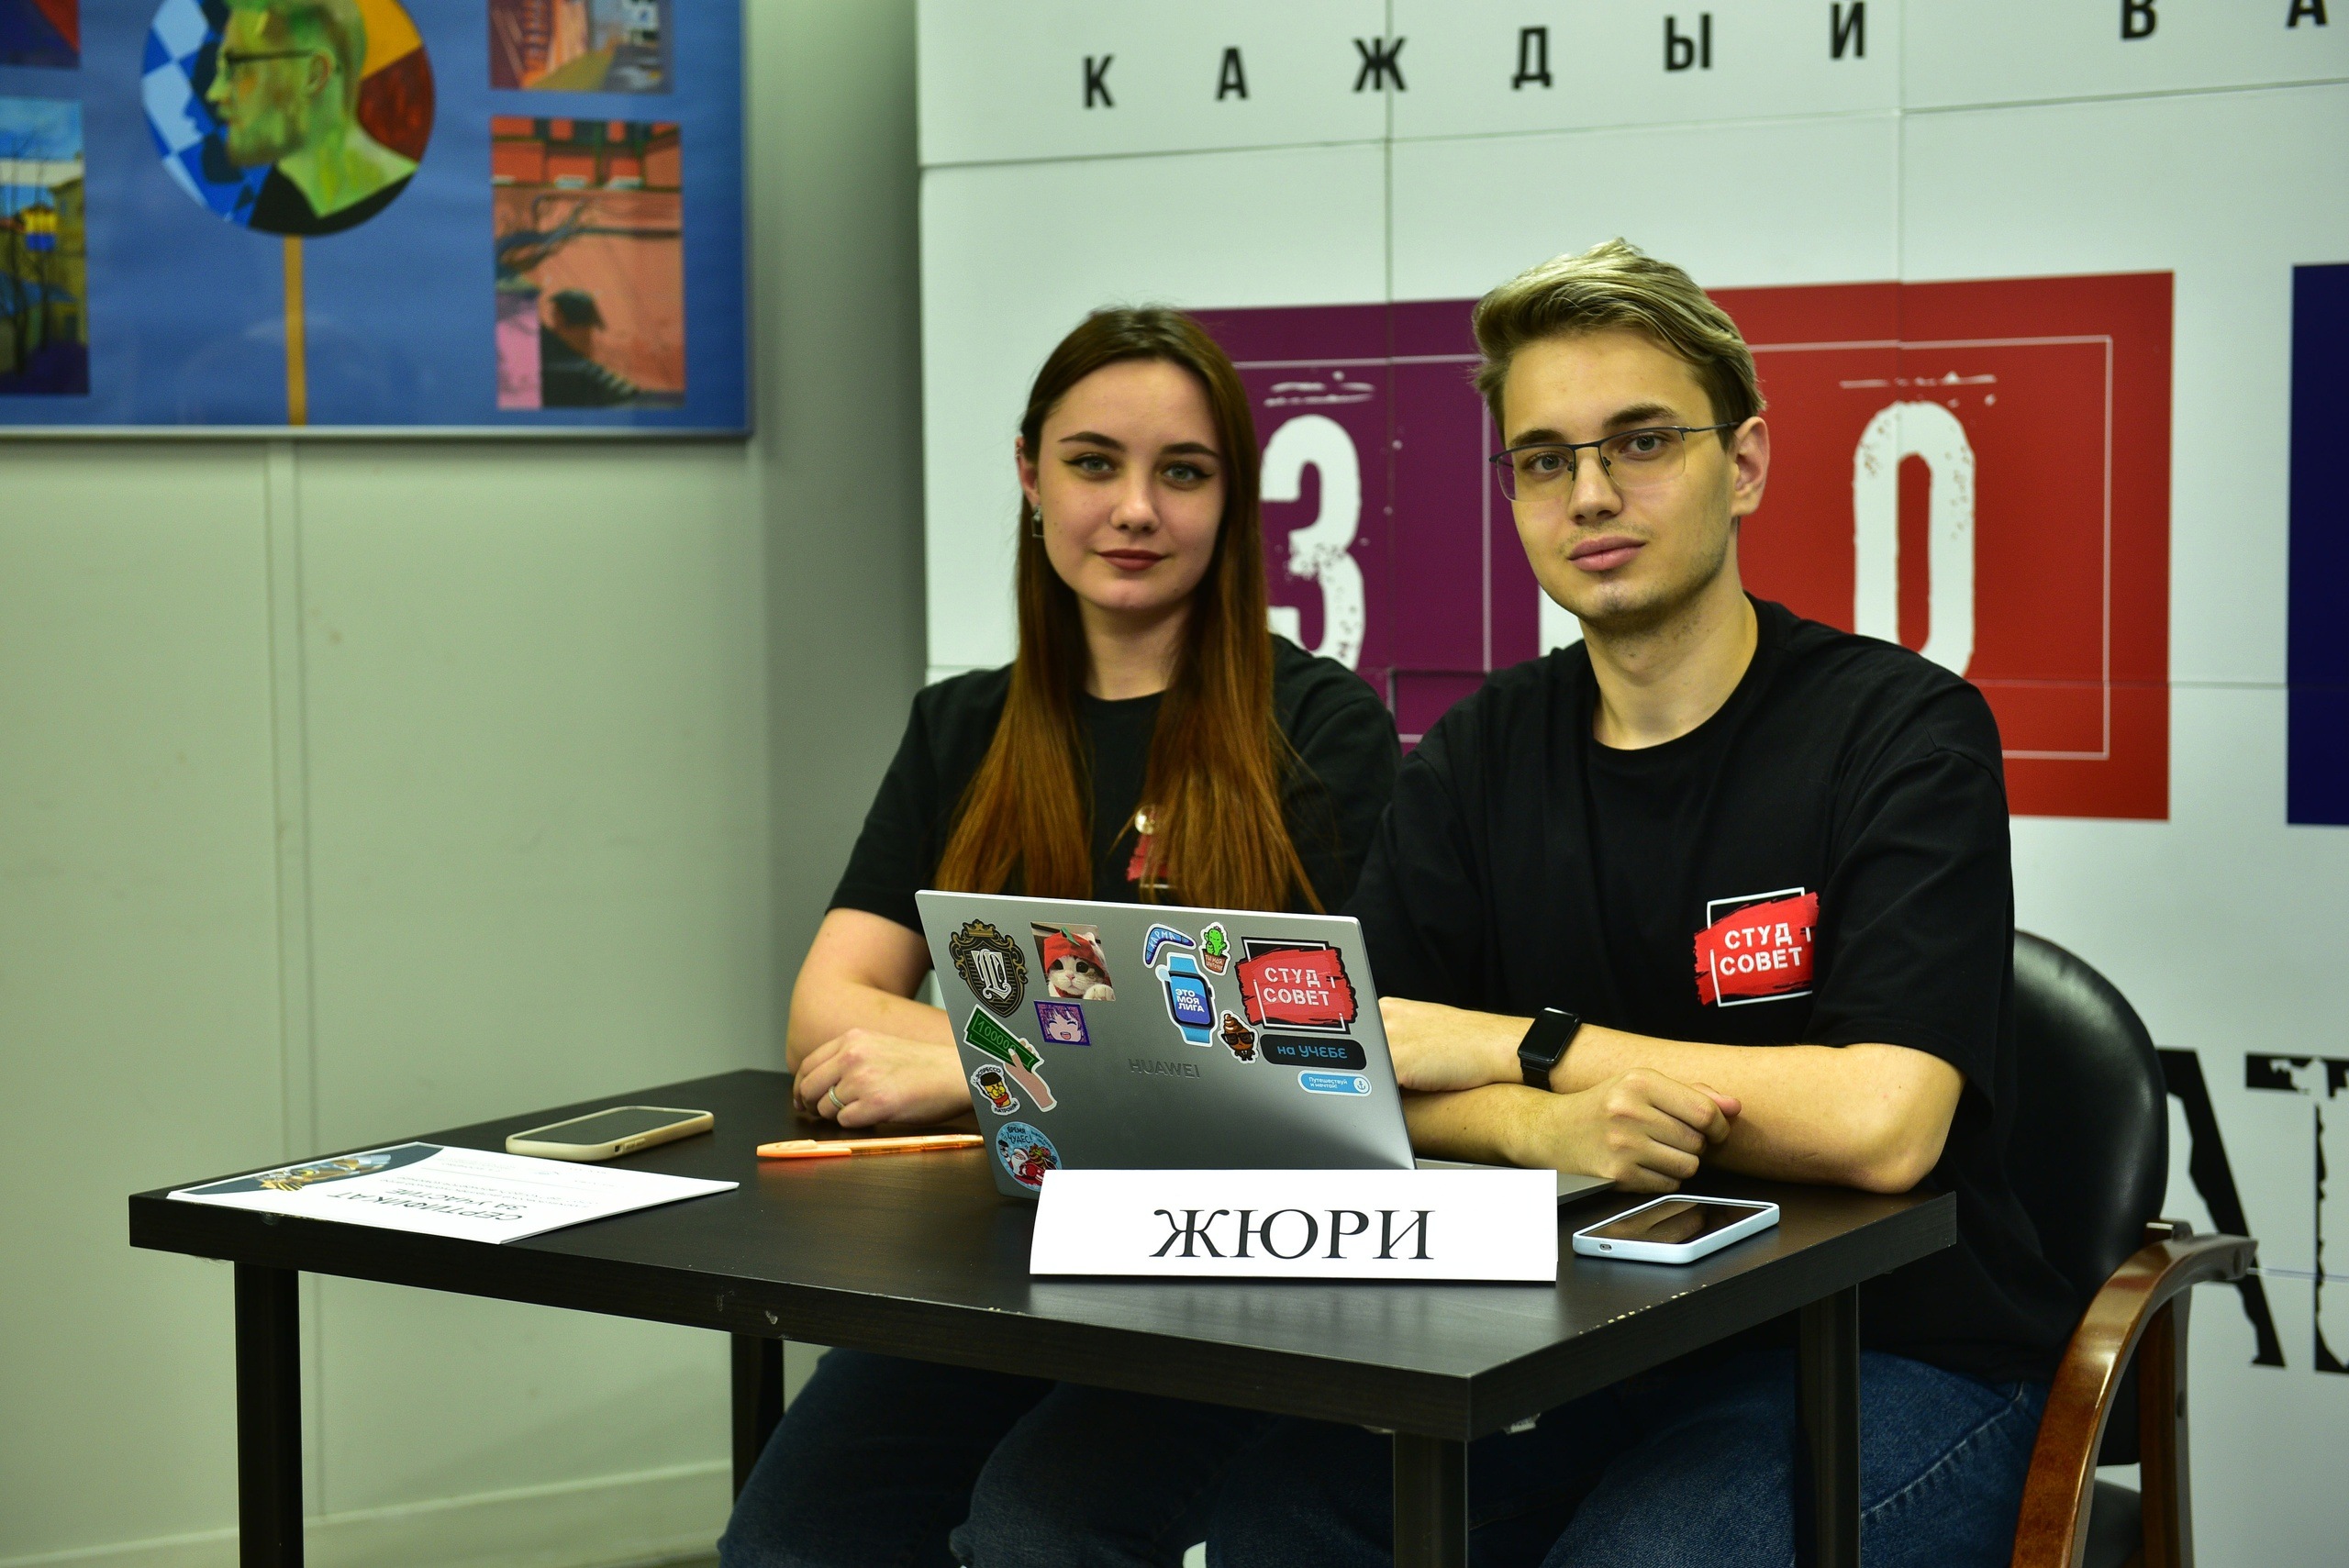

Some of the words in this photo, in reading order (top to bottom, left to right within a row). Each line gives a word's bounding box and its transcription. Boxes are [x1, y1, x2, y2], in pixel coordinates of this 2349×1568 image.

[1149, 930, 1175, 949] КАРМА
[1724, 922, 1793, 950] СТУД
[1719, 946, 1803, 976] СОВЕТ
[1264, 967, 1321, 988] СТУД
[1174, 988, 1196, 997] ЭТО
[1176, 995, 1200, 1005] МОЯ
[1263, 987, 1330, 1006] СОВЕТ
[1178, 1003, 1205, 1013] ЛИГА
[1276, 1045, 1296, 1056] на
[1128, 1058, 1201, 1079] HUAWEI
[1308, 1076, 1348, 1085] Путешествуй
[1007, 1126, 1026, 1135] ВРЕМЯ
[1007, 1131, 1033, 1144] ЧУДЕС!
[327, 1191, 523, 1221] СЕРТИФИКАТ
[385, 1188, 493, 1207] УЧАСТИЕ
[1149, 1208, 1436, 1260] ЖЮРИ
